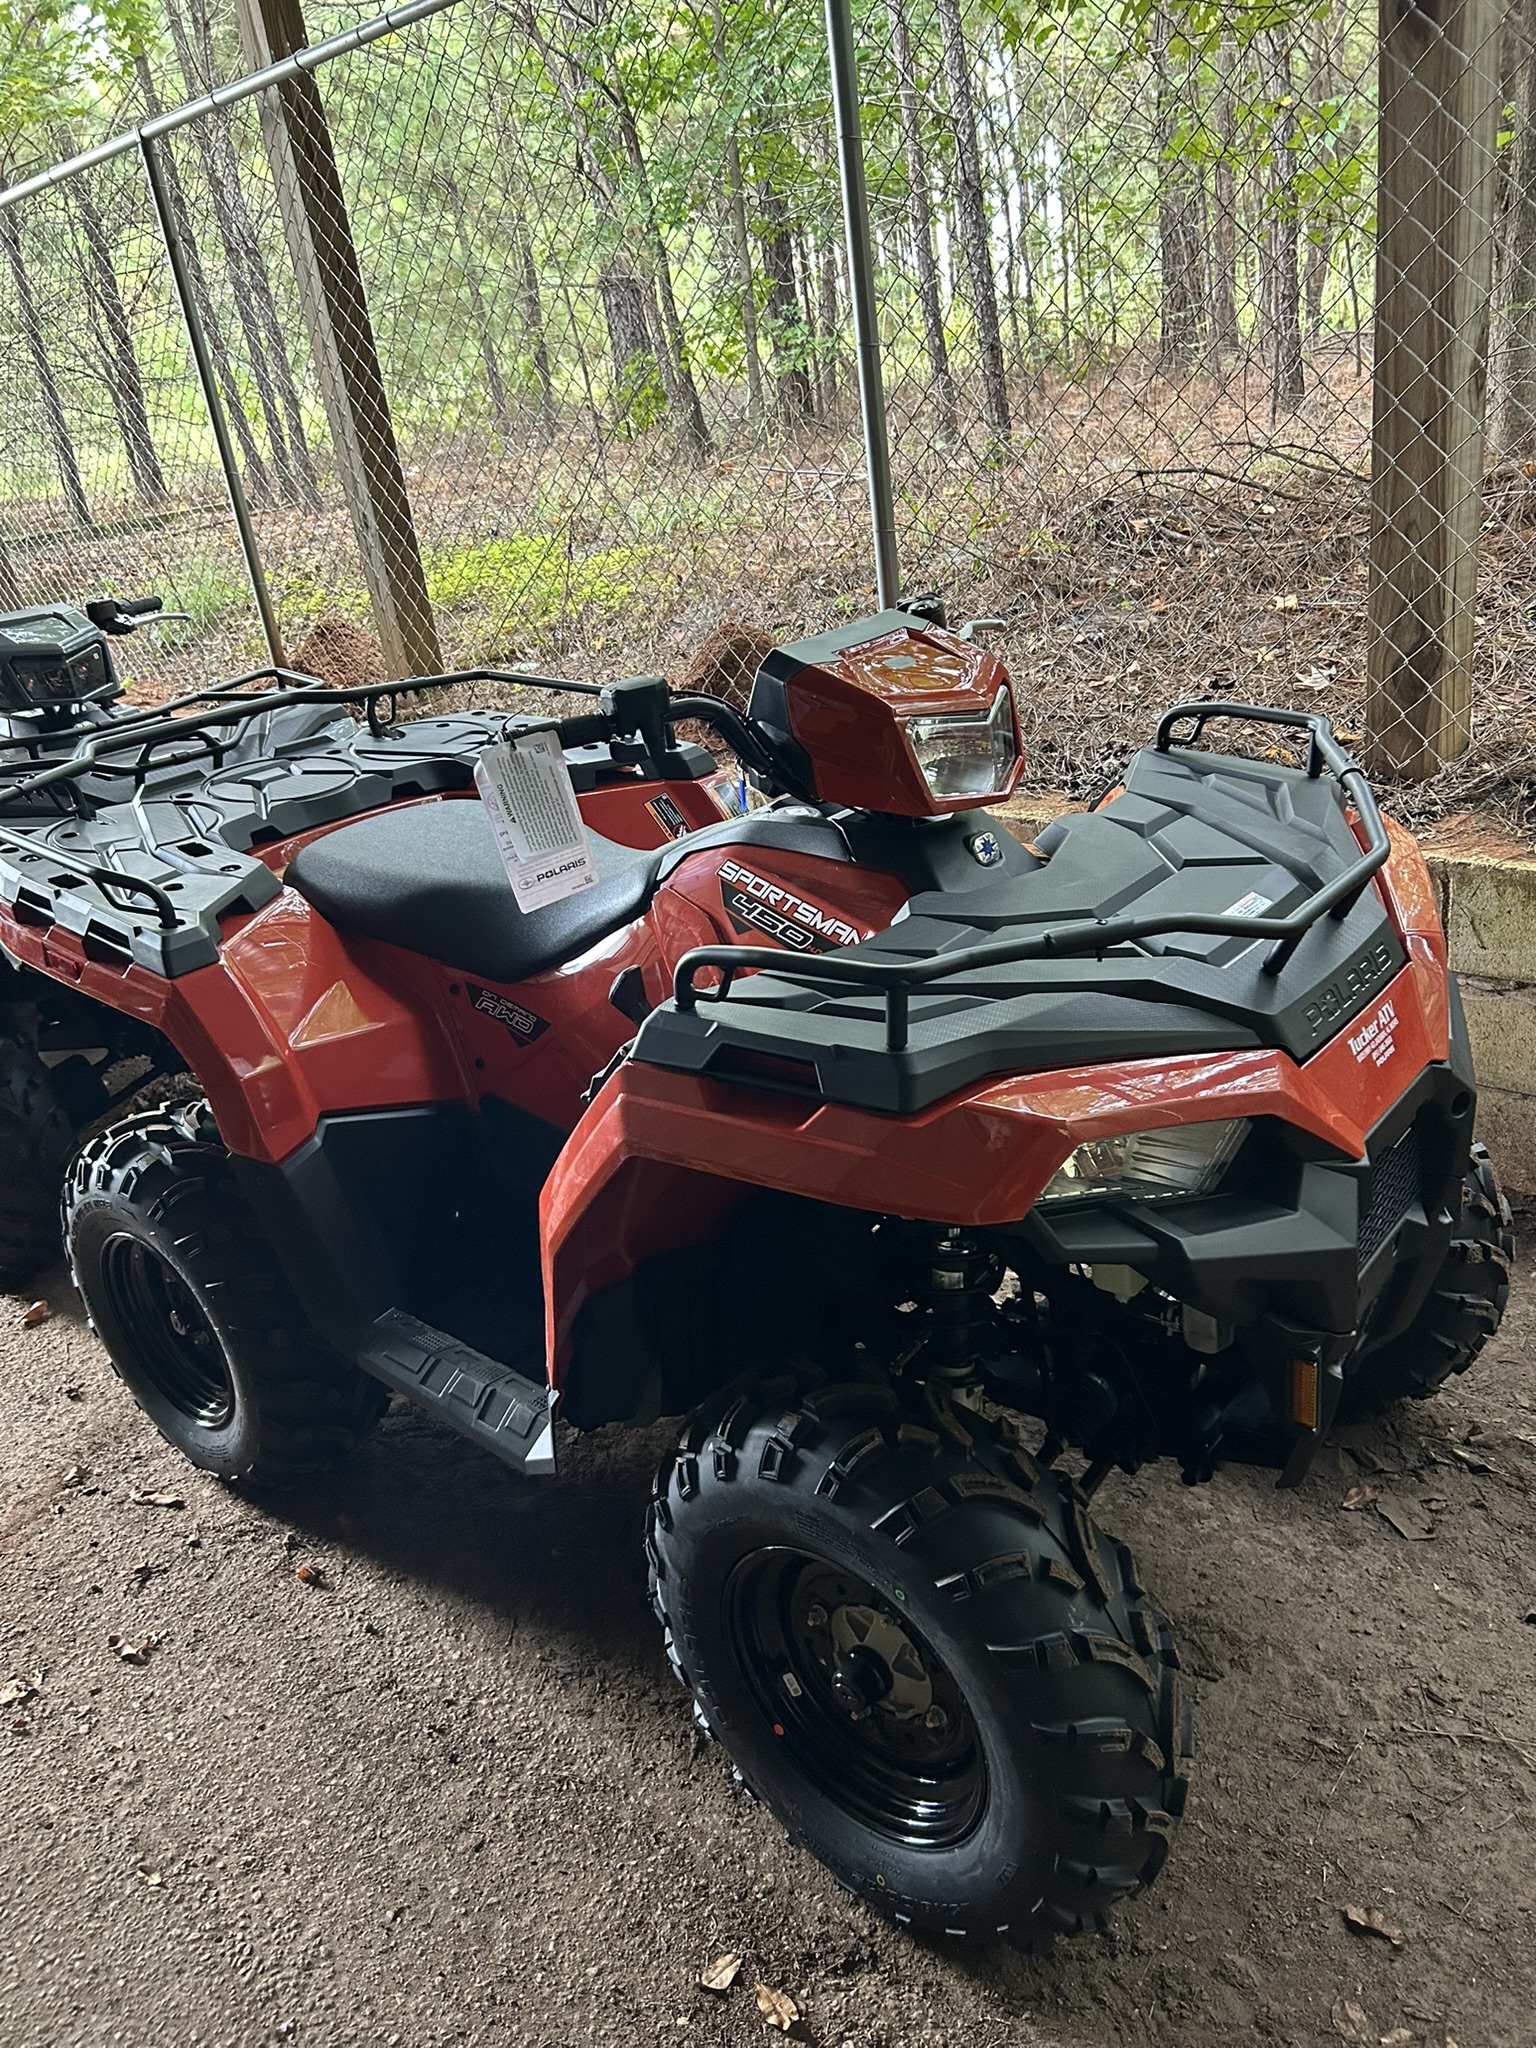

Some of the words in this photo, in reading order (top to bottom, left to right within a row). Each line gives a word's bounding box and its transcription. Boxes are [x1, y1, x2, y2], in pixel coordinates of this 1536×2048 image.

[496, 783, 514, 818] WARNING
[536, 857, 587, 882] POLARIS
[717, 860, 876, 946] SPORTSMAN
[731, 893, 814, 950] 450
[481, 990, 498, 1001] ON
[499, 998, 538, 1023] DEMAND
[1302, 940, 1393, 1037] POLARIS
[474, 996, 534, 1034] AWD
[1347, 1018, 1380, 1057] Tucker
[1376, 998, 1396, 1029] ATV
